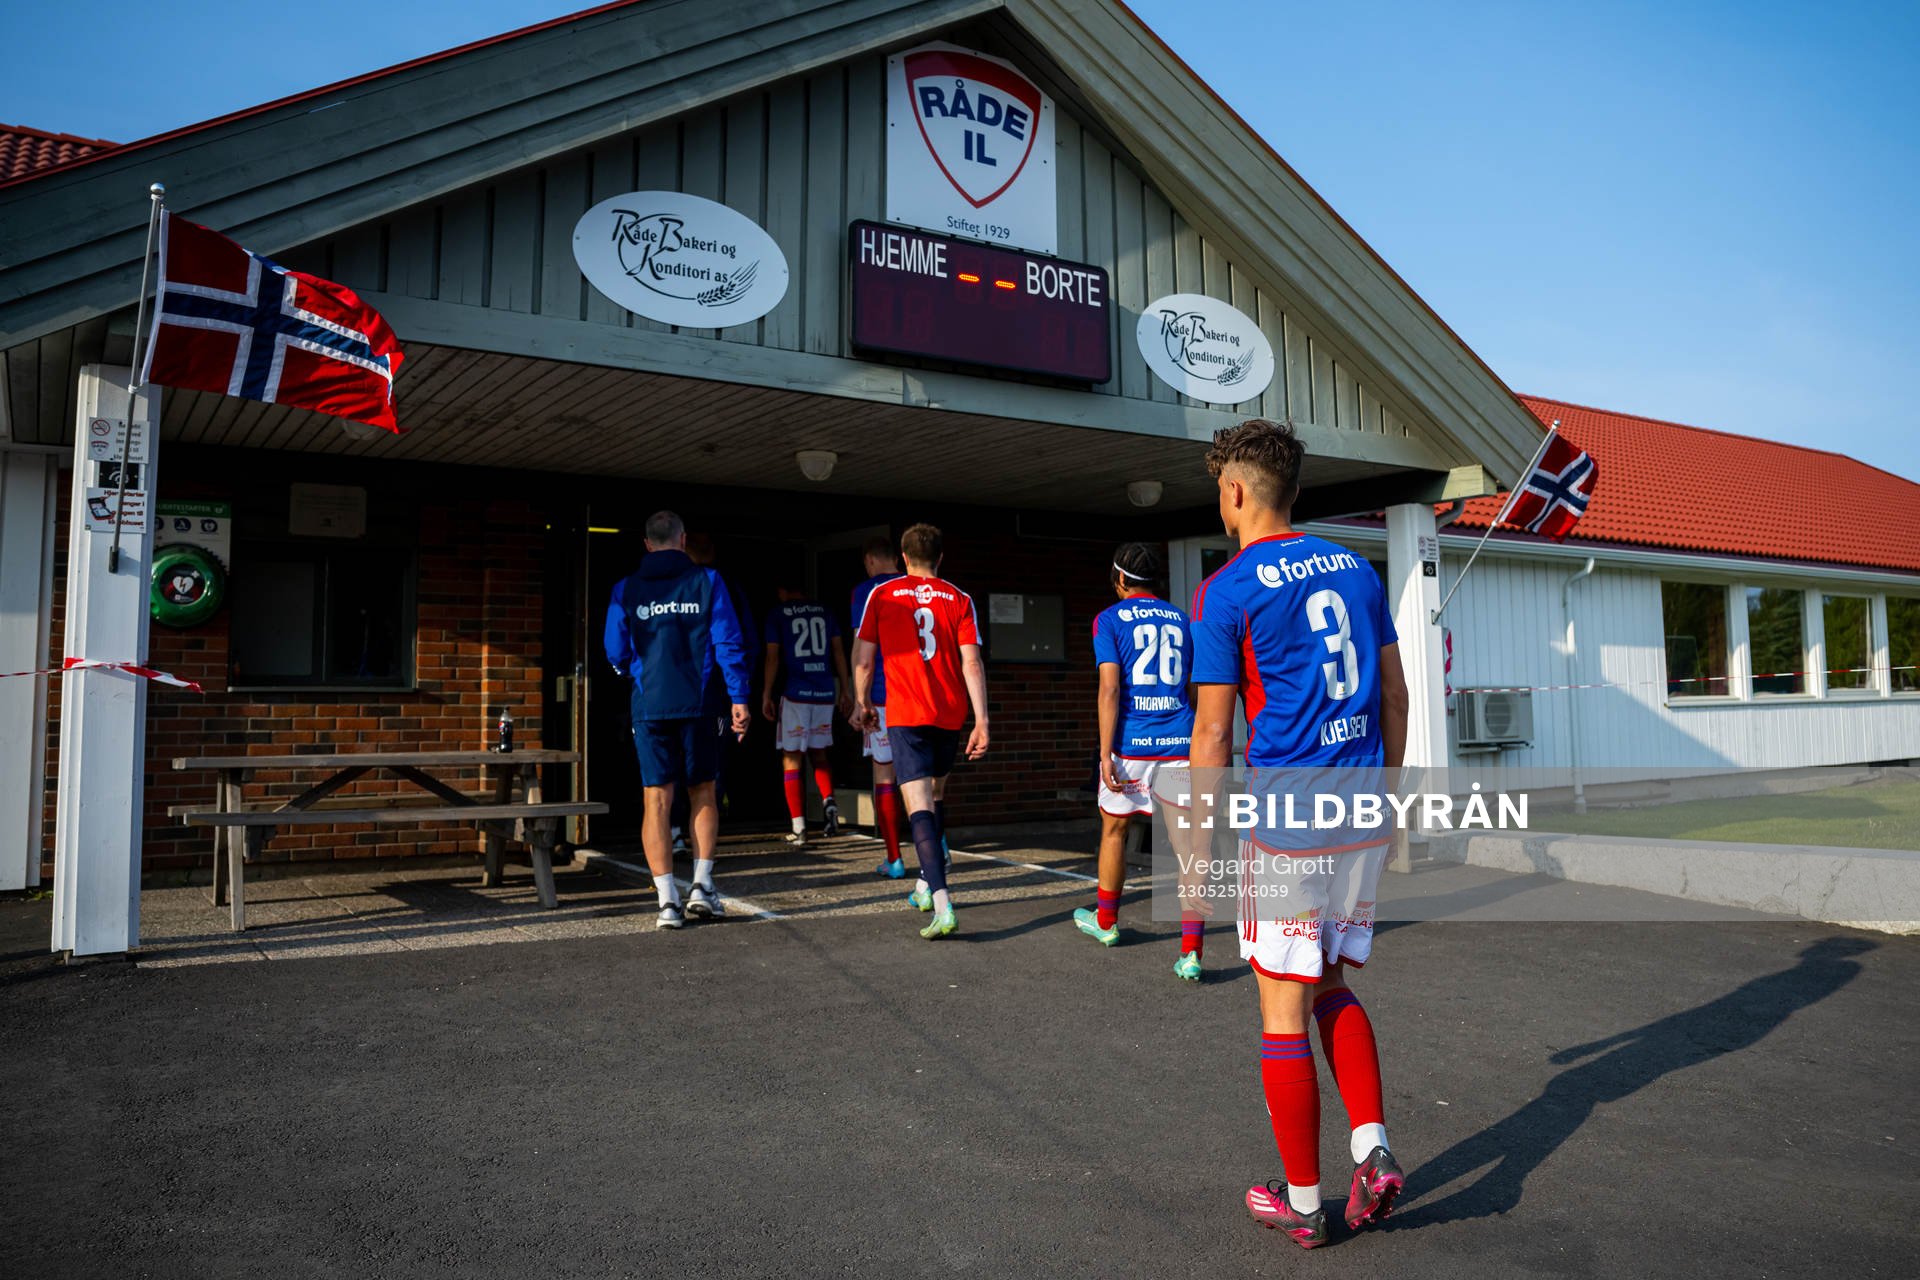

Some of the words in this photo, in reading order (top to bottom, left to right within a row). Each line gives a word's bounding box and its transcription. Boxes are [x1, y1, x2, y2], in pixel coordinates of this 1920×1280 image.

[918, 79, 1028, 141] RÅDE
[964, 129, 997, 168] IL
[611, 209, 658, 246] Råde
[658, 217, 717, 253] Bakeri
[721, 244, 736, 259] og
[947, 214, 981, 235] Stiftet
[984, 225, 1010, 240] 1929
[626, 243, 711, 281] Konditori
[714, 271, 728, 284] as
[861, 228, 948, 278] HJEMME
[1025, 260, 1102, 307] BORTE
[1160, 309, 1190, 338] Råde
[1189, 315, 1228, 343] Bakeri
[1230, 335, 1241, 348] og
[1171, 336, 1225, 366] Konditori
[1226, 357, 1237, 367] as
[1279, 553, 1359, 583] fortum
[650, 600, 700, 617] fortum
[793, 604, 825, 615] fortum
[1132, 605, 1182, 622] fortum
[791, 616, 827, 658] 20
[913, 606, 937, 661] 3
[1305, 588, 1360, 701] 3
[1132, 623, 1184, 686] 26
[1132, 735, 1153, 746] mot
[1320, 714, 1369, 747] KJELSEN
